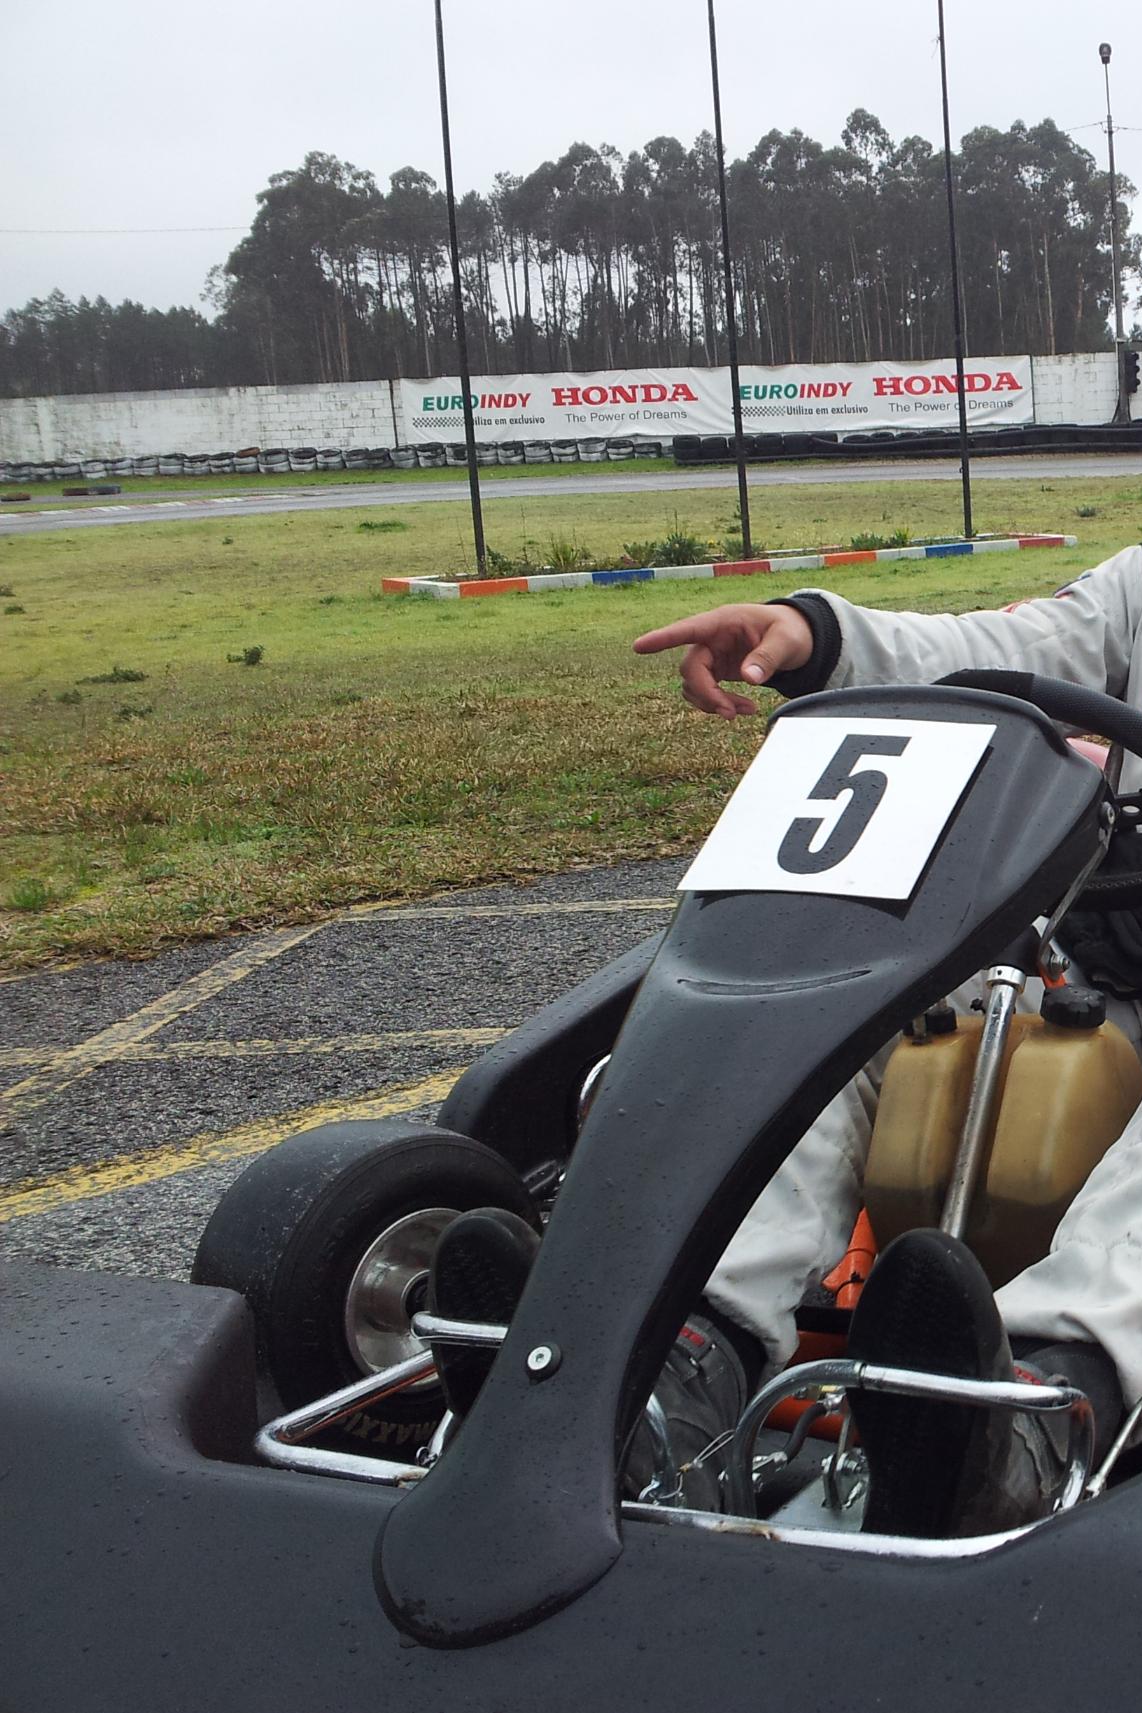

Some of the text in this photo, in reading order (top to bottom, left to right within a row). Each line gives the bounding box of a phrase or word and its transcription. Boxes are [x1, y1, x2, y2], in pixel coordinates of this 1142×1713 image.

[740, 381, 854, 400] EUROINDY
[872, 372, 1023, 396] HONDA
[551, 383, 698, 406] HONDA
[786, 404, 869, 416] Utiliza em exclusivo
[888, 402, 910, 413] The
[914, 401, 950, 412] Power
[968, 400, 1014, 410] Dreams
[509, 414, 545, 425] exclusivo
[565, 410, 688, 423] The Power of Dreams
[776, 734, 912, 874] 5
